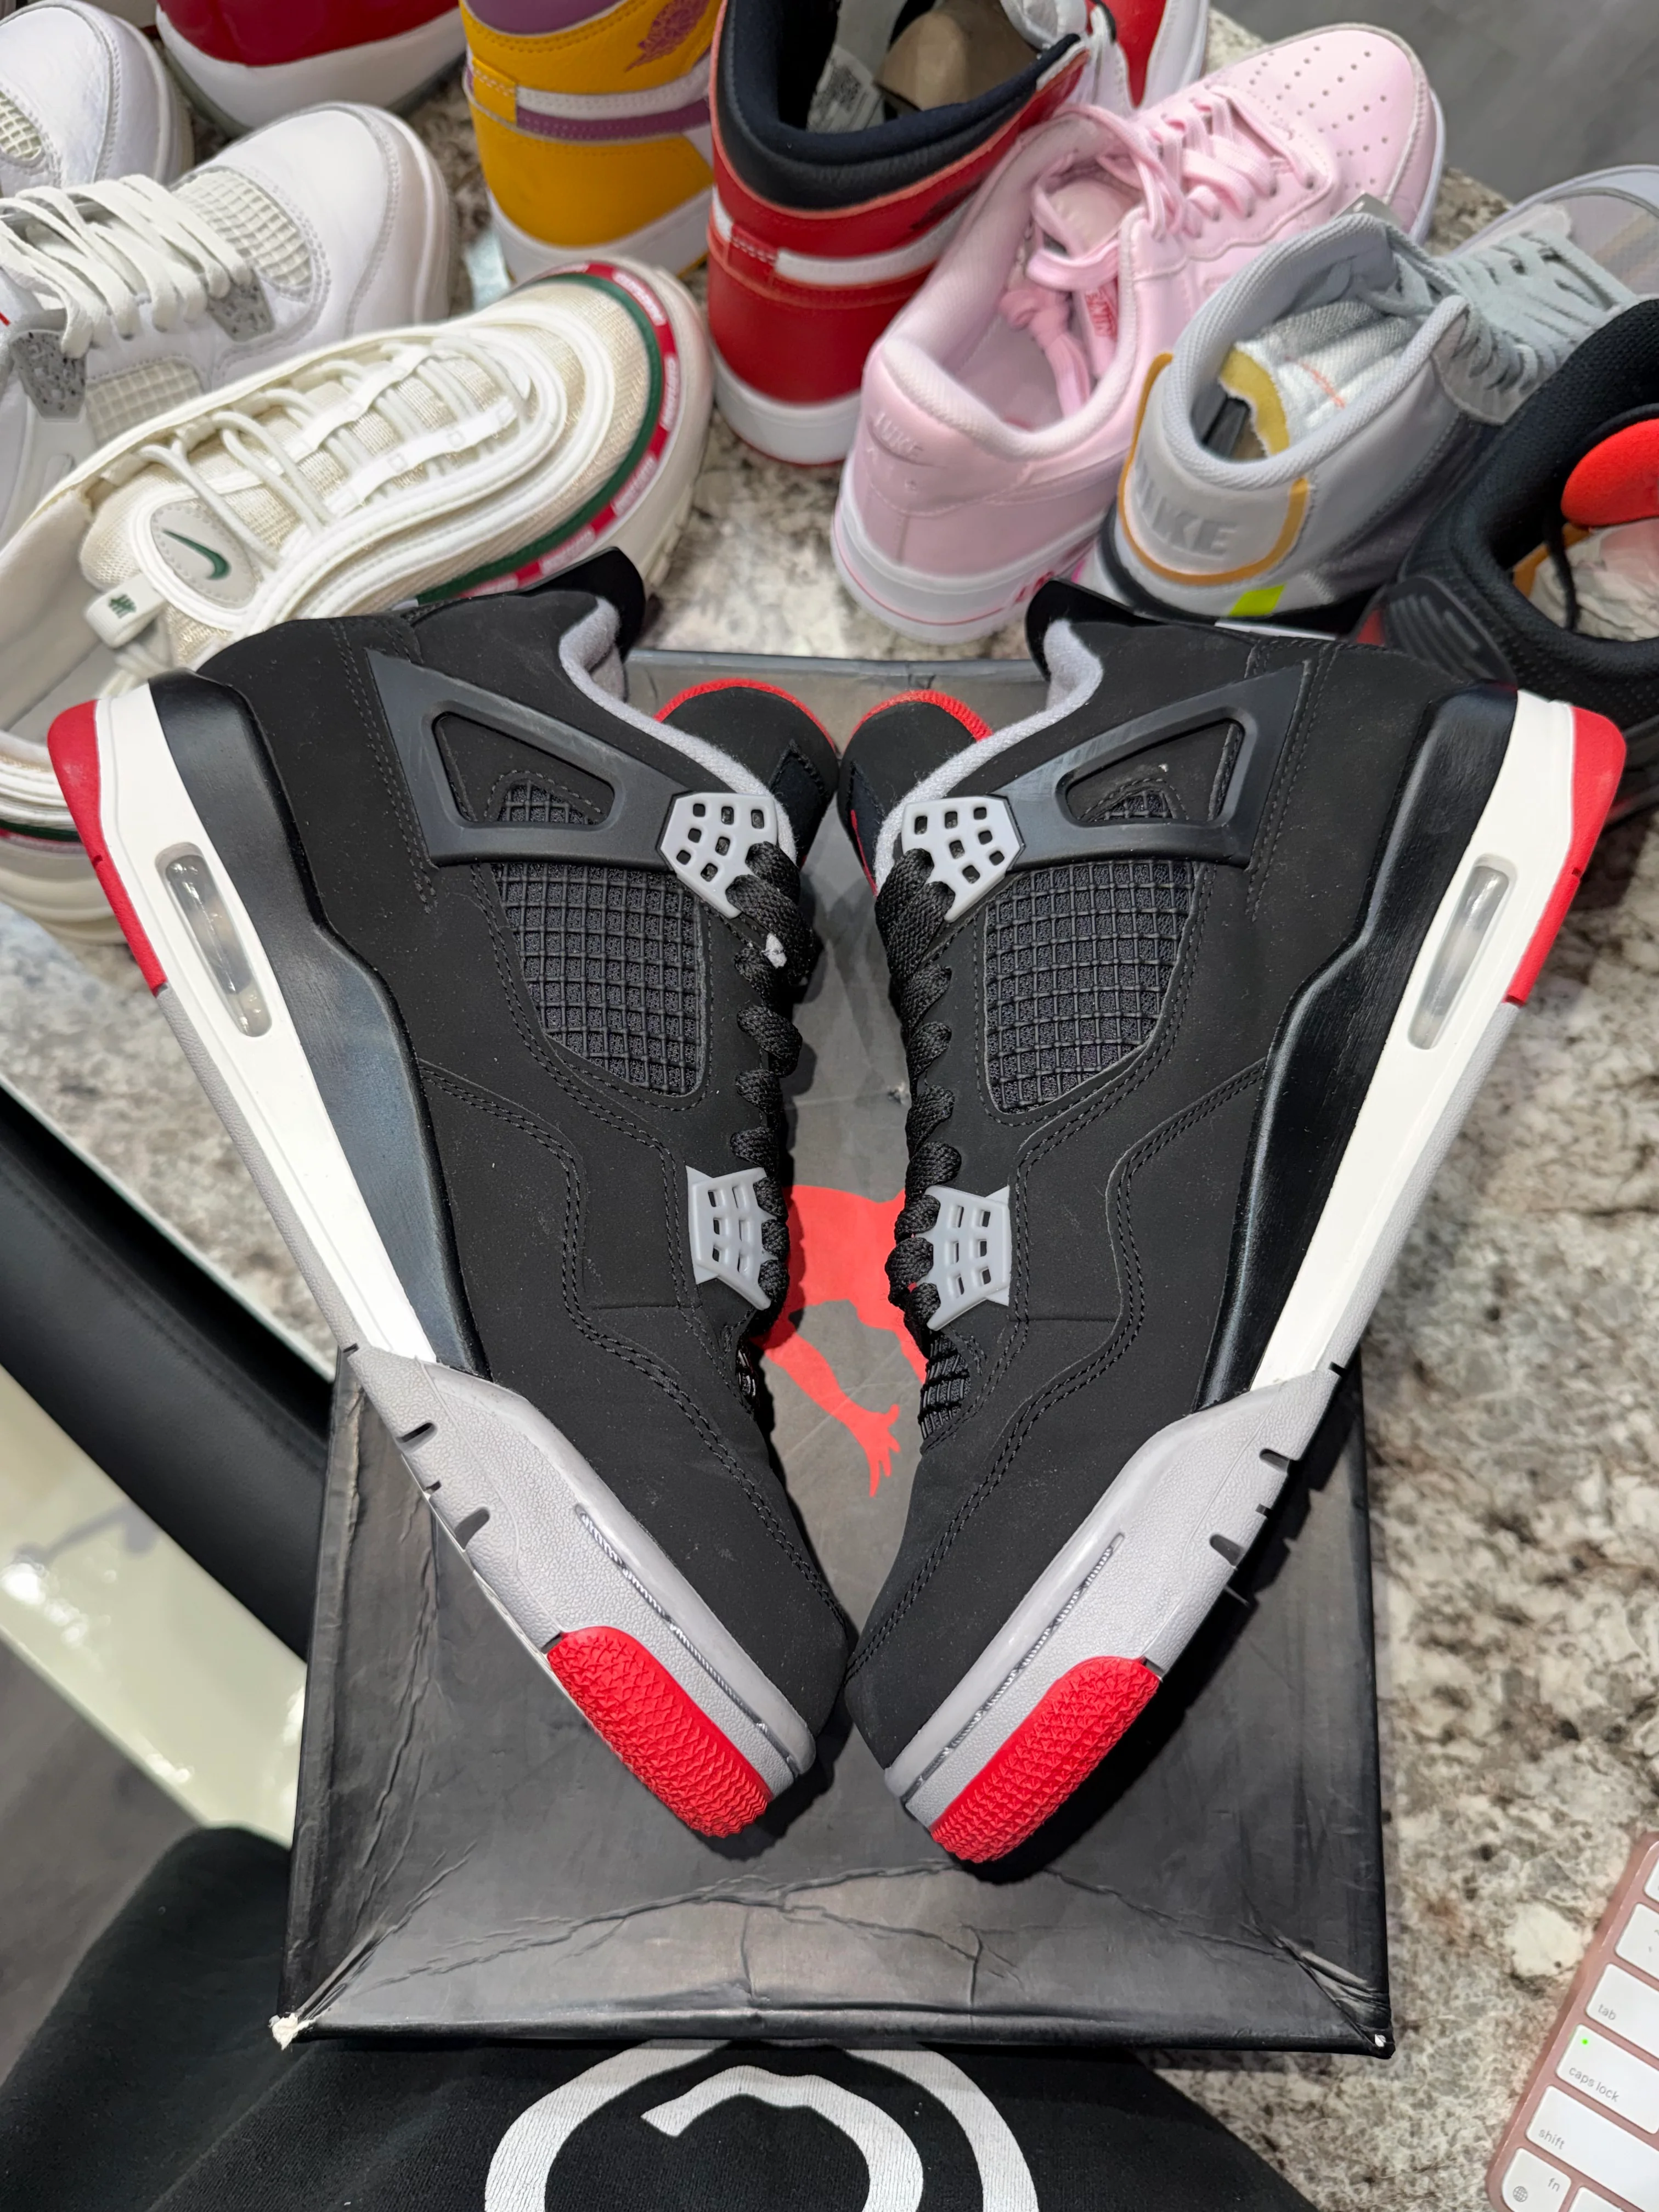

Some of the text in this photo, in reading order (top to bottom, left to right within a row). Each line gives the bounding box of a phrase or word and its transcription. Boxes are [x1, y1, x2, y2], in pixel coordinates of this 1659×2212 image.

[1136, 461, 1238, 557] NIKE
[1598, 2004, 1616, 2021] tab
[1569, 2067, 1620, 2102] caps lock
[1538, 2129, 1565, 2149] shift
[1548, 2178, 1560, 2192] fn
